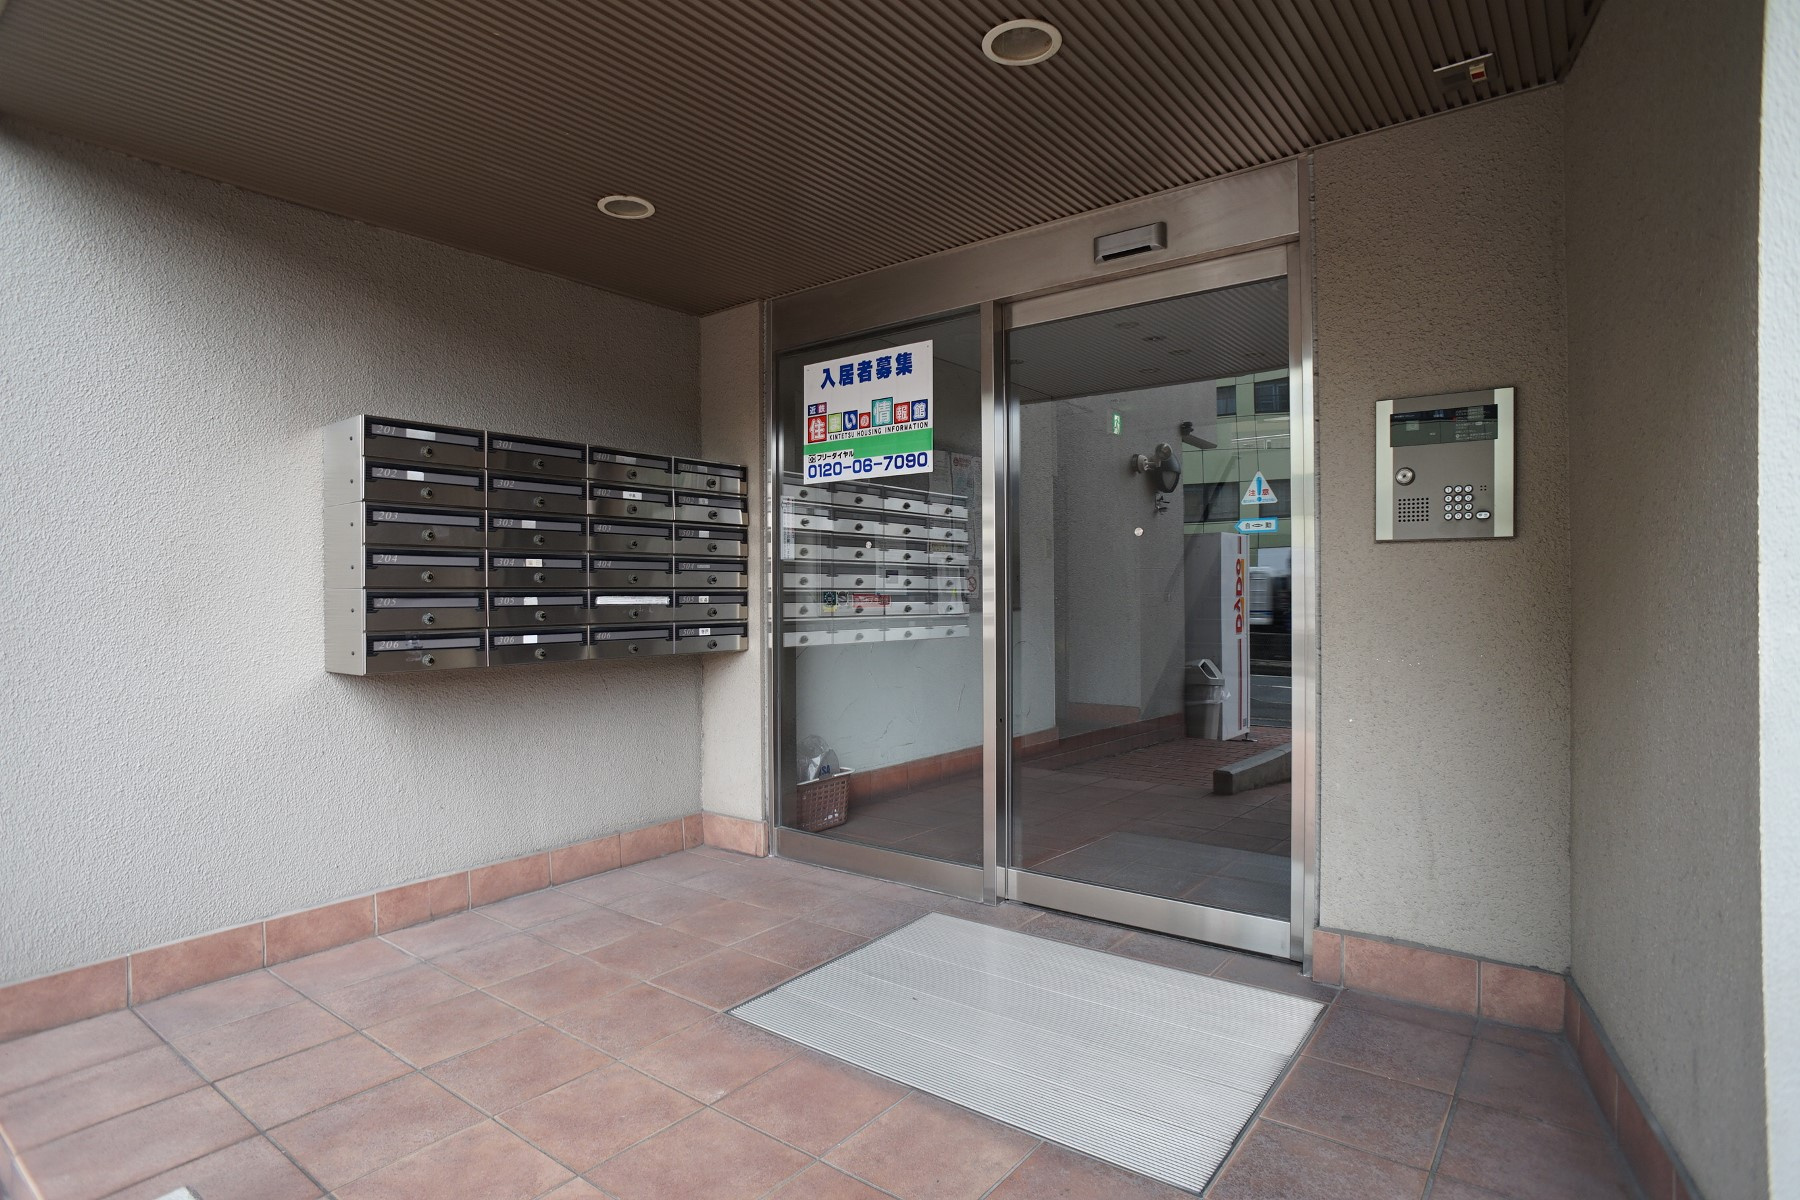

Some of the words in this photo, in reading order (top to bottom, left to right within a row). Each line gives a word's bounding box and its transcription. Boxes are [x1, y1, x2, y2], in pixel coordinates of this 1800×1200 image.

[821, 352, 913, 390] 入居者募集
[809, 404, 827, 416] 近鉄
[808, 400, 927, 442] 住まいの情報館
[377, 424, 396, 435] 201
[829, 431, 855, 441] KINTETSU
[857, 427, 882, 437] HOUSING
[885, 421, 929, 433] INFORMATION
[497, 440, 513, 449] 301
[596, 452, 610, 460] 401
[817, 450, 854, 462] フリーダイヤル
[808, 451, 928, 479] 0120-06-7090
[377, 467, 398, 478] 202
[497, 479, 515, 488] 302
[597, 488, 611, 496] 402
[378, 511, 399, 520] 203
[497, 518, 514, 527] 303
[597, 524, 612, 532] 403
[378, 554, 398, 563] 204
[498, 558, 515, 567] 304
[597, 560, 612, 568] 404
[377, 598, 397, 607] 205
[498, 597, 515, 605] 305
[498, 636, 515, 644] 306
[596, 632, 611, 640] 406
[378, 640, 399, 649] 206
